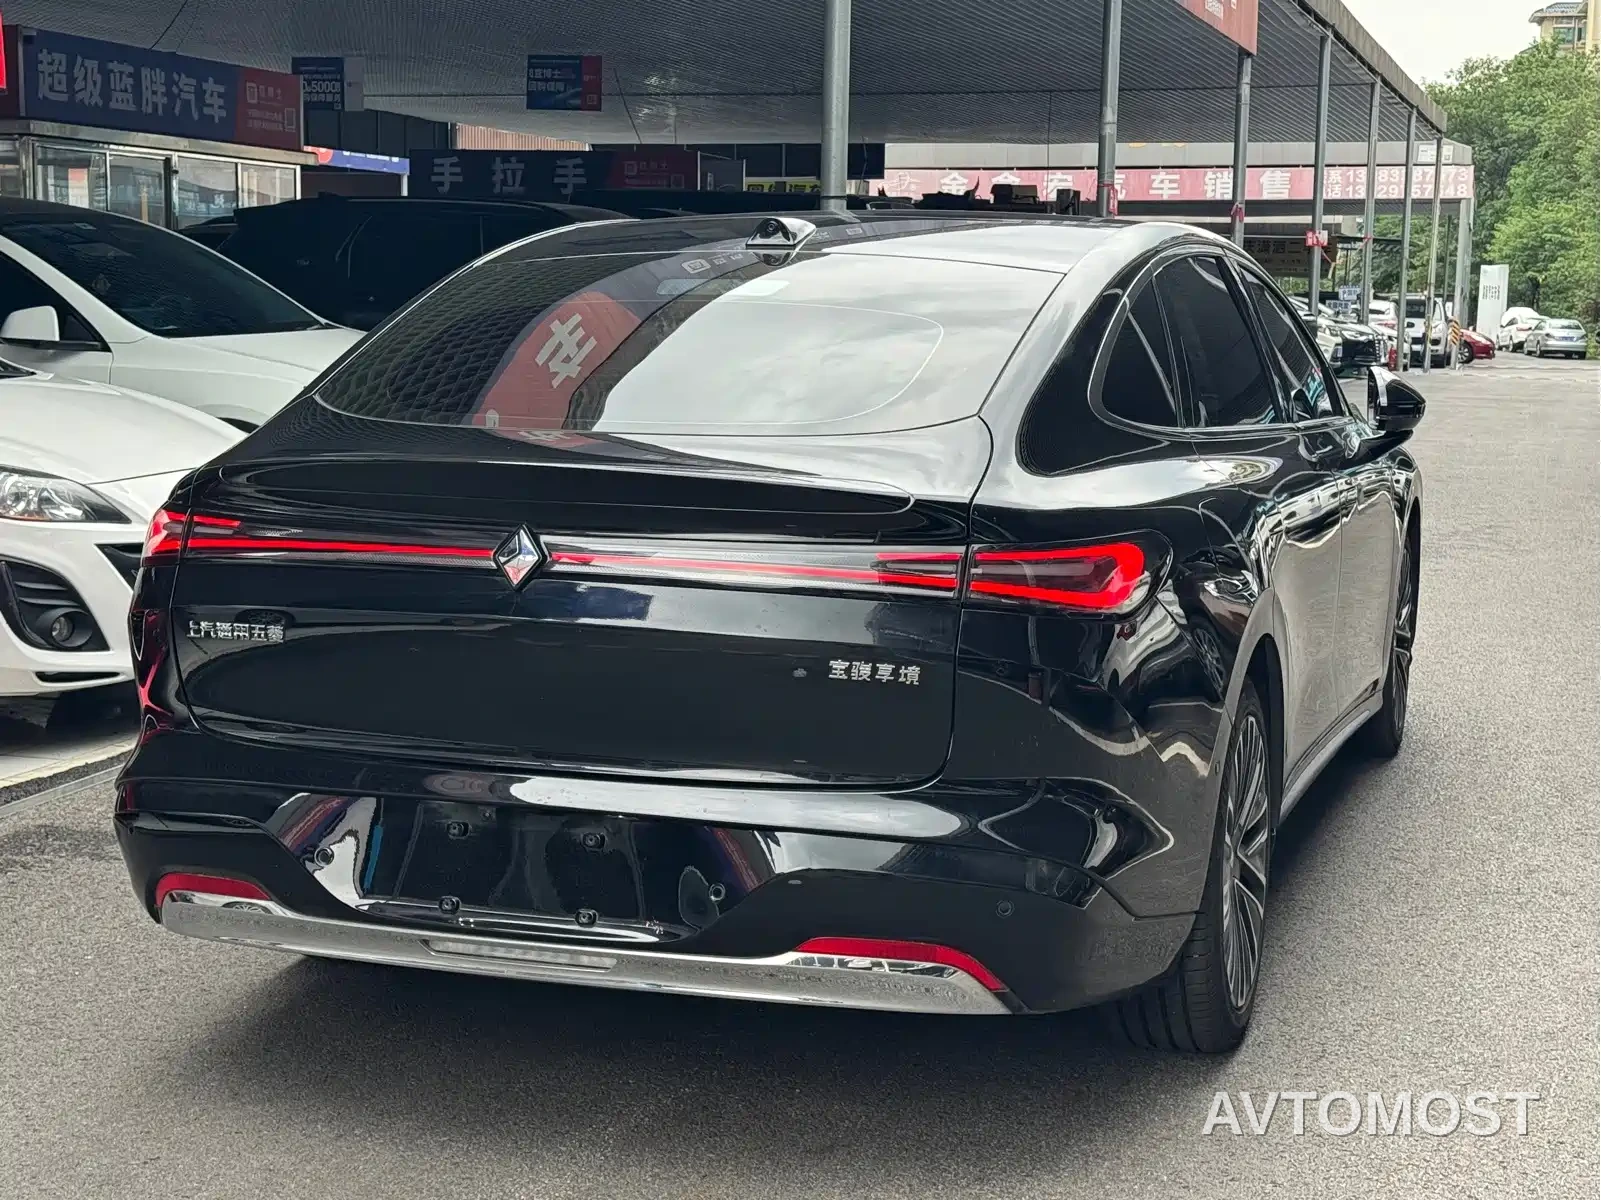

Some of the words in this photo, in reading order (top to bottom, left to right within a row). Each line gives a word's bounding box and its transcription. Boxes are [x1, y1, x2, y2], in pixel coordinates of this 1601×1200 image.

[36, 48, 228, 124] 超级蓝胖汽车
[431, 156, 587, 194] 手拉手
[1323, 169, 1342, 182] 系
[1323, 183, 1342, 198] 话
[1345, 183, 1468, 198] 13295748
[186, 620, 284, 643] 上汽通用五菱
[828, 659, 921, 685] 宝骏享境
